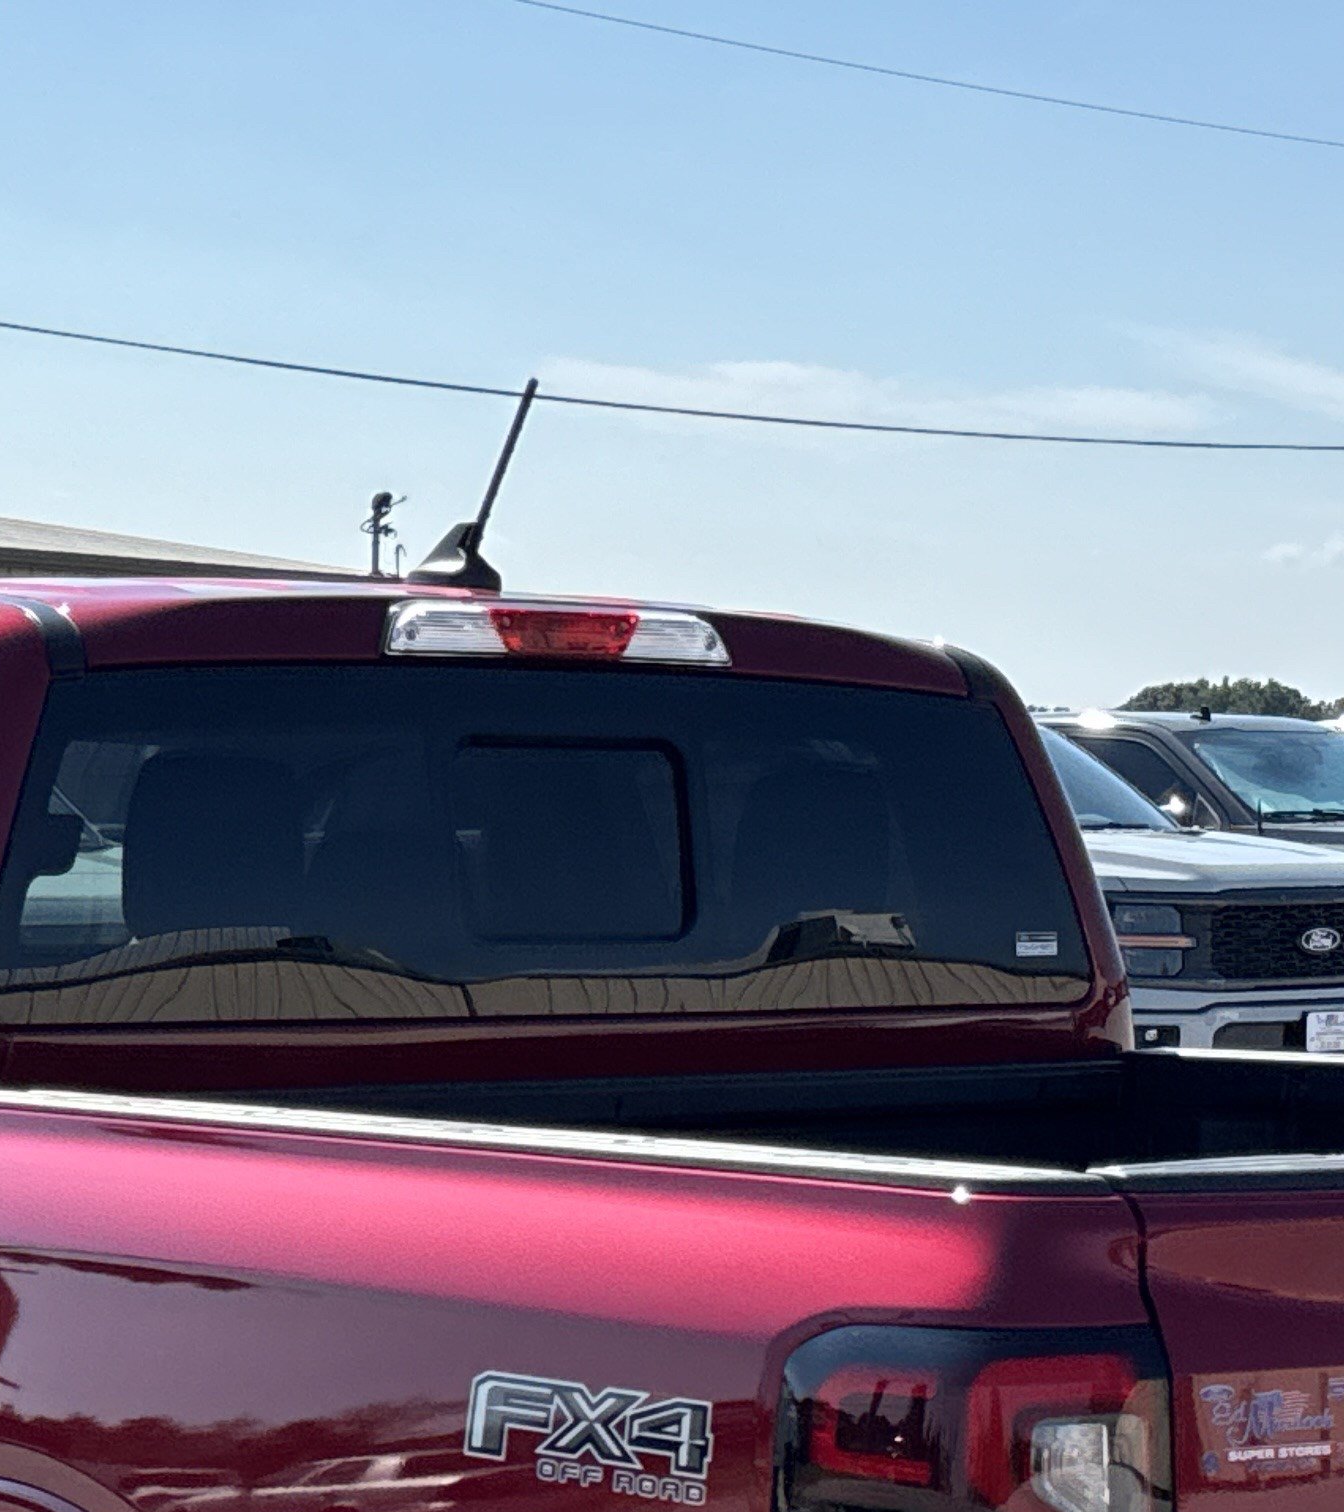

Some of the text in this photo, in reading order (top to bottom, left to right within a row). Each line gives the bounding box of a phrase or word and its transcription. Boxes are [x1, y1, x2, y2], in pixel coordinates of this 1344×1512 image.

[463, 1369, 714, 1480] FX4
[1228, 1443, 1332, 1462] SUPER STORES
[537, 1457, 707, 1507] OFF ROAD
